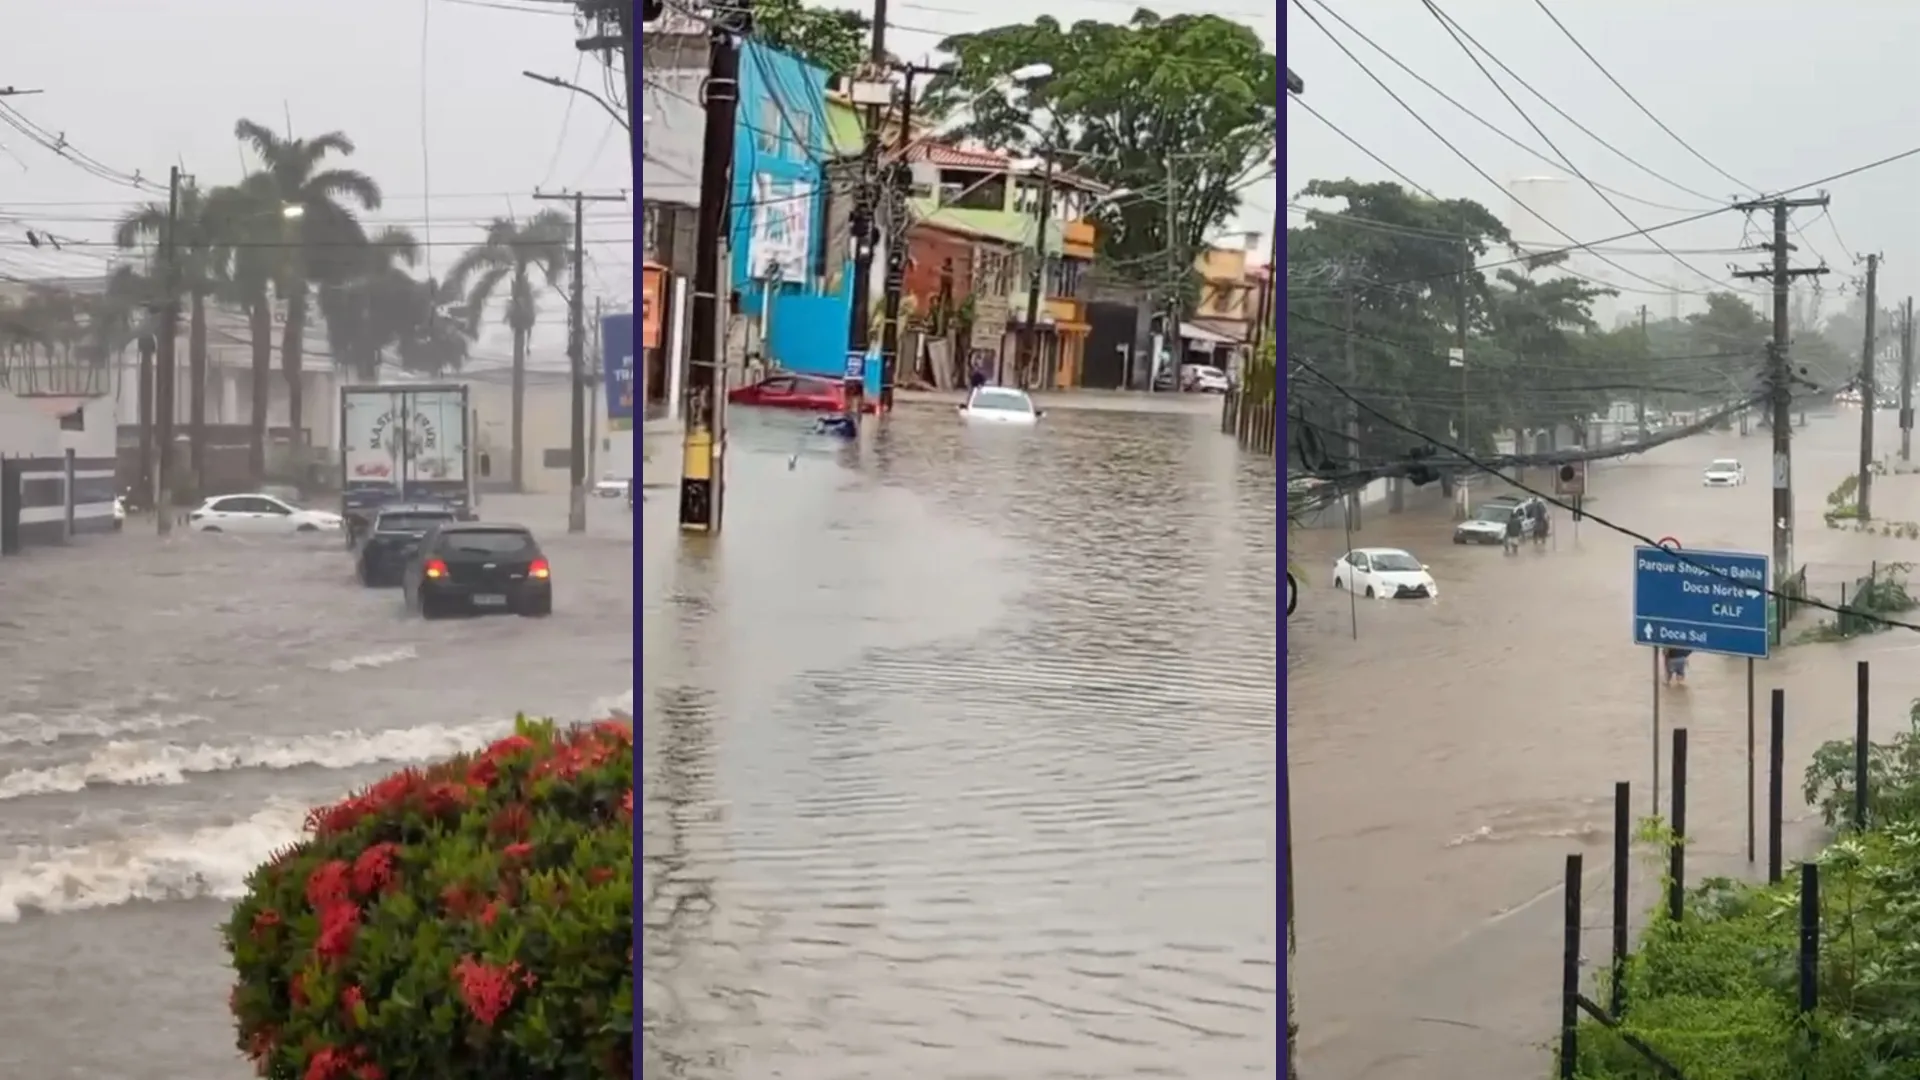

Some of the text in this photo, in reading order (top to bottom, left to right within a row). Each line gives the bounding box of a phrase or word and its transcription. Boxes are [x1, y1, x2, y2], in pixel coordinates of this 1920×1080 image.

[1638, 558, 1675, 573] Parque
[1730, 566, 1763, 581] Bahia
[1683, 580, 1745, 598] Doca Norte
[1712, 603, 1744, 618] CALF
[1659, 626, 1707, 643] Doca Sul
